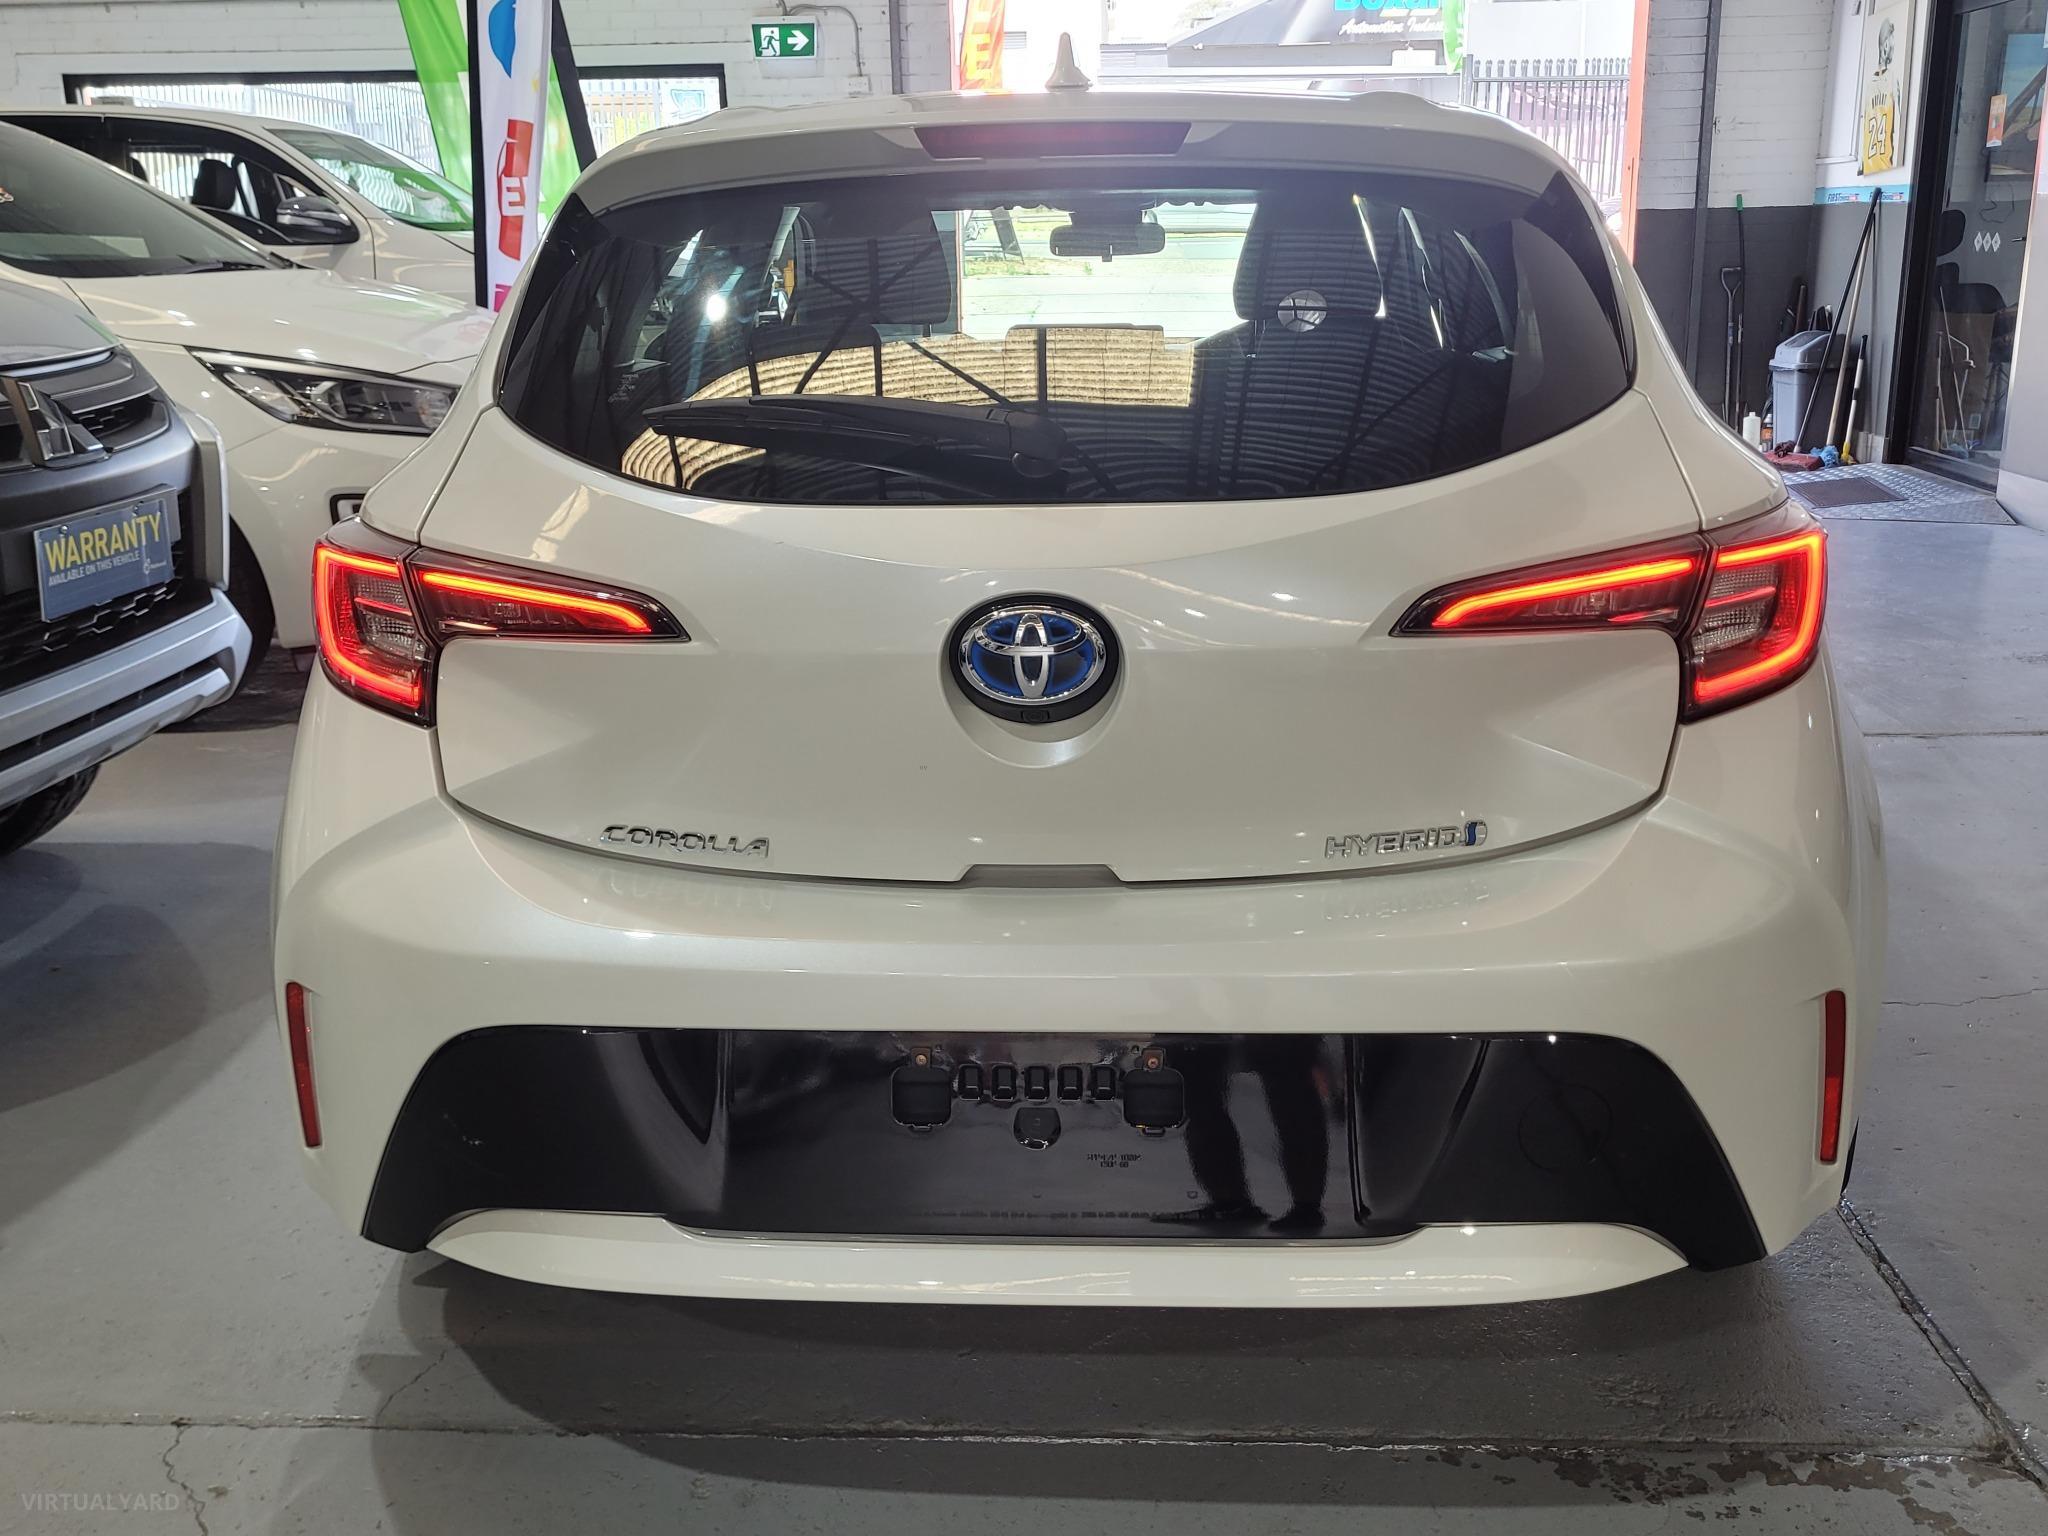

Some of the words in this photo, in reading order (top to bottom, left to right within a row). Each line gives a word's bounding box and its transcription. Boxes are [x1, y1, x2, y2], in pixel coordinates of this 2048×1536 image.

[1868, 113, 1887, 159] 24
[44, 511, 162, 574] WARRANTY
[48, 566, 85, 587] AVAILABLE
[86, 564, 97, 575] ON
[97, 559, 112, 570] THIS
[114, 550, 140, 566] VEHICLE
[600, 824, 771, 858] COROLLA
[1325, 826, 1461, 859] HYBRID
